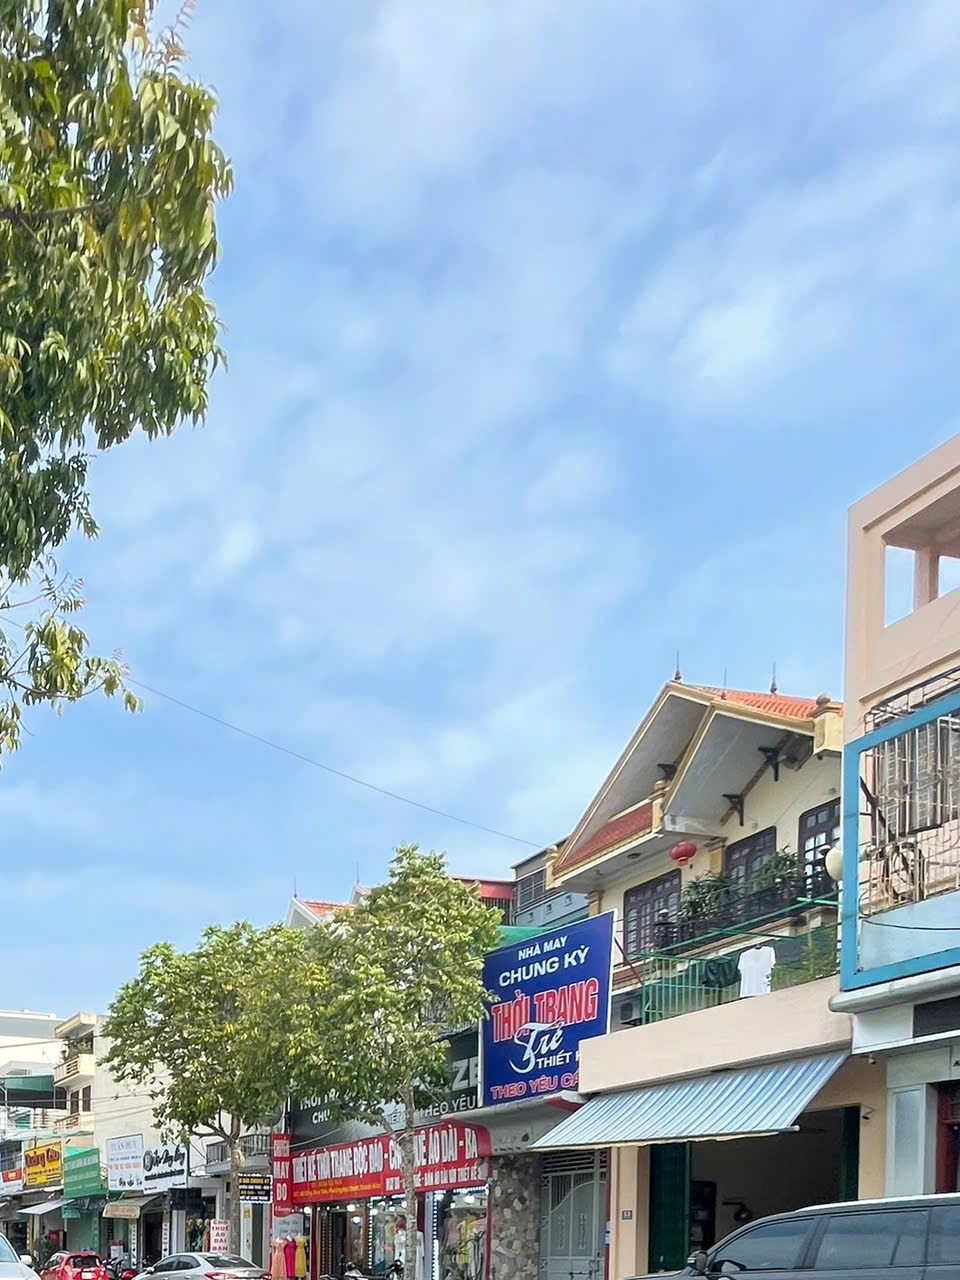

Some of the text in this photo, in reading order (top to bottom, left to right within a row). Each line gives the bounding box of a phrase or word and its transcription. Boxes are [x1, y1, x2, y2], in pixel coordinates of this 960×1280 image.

[518, 935, 568, 961] NHÀ MAY
[499, 956, 560, 987] CHUNG
[534, 977, 599, 1030] TRANG
[509, 1016, 566, 1074] Trẻ
[490, 1081, 527, 1100] THEO
[529, 1074, 559, 1094] YÊU
[452, 1094, 476, 1113] YÊU
